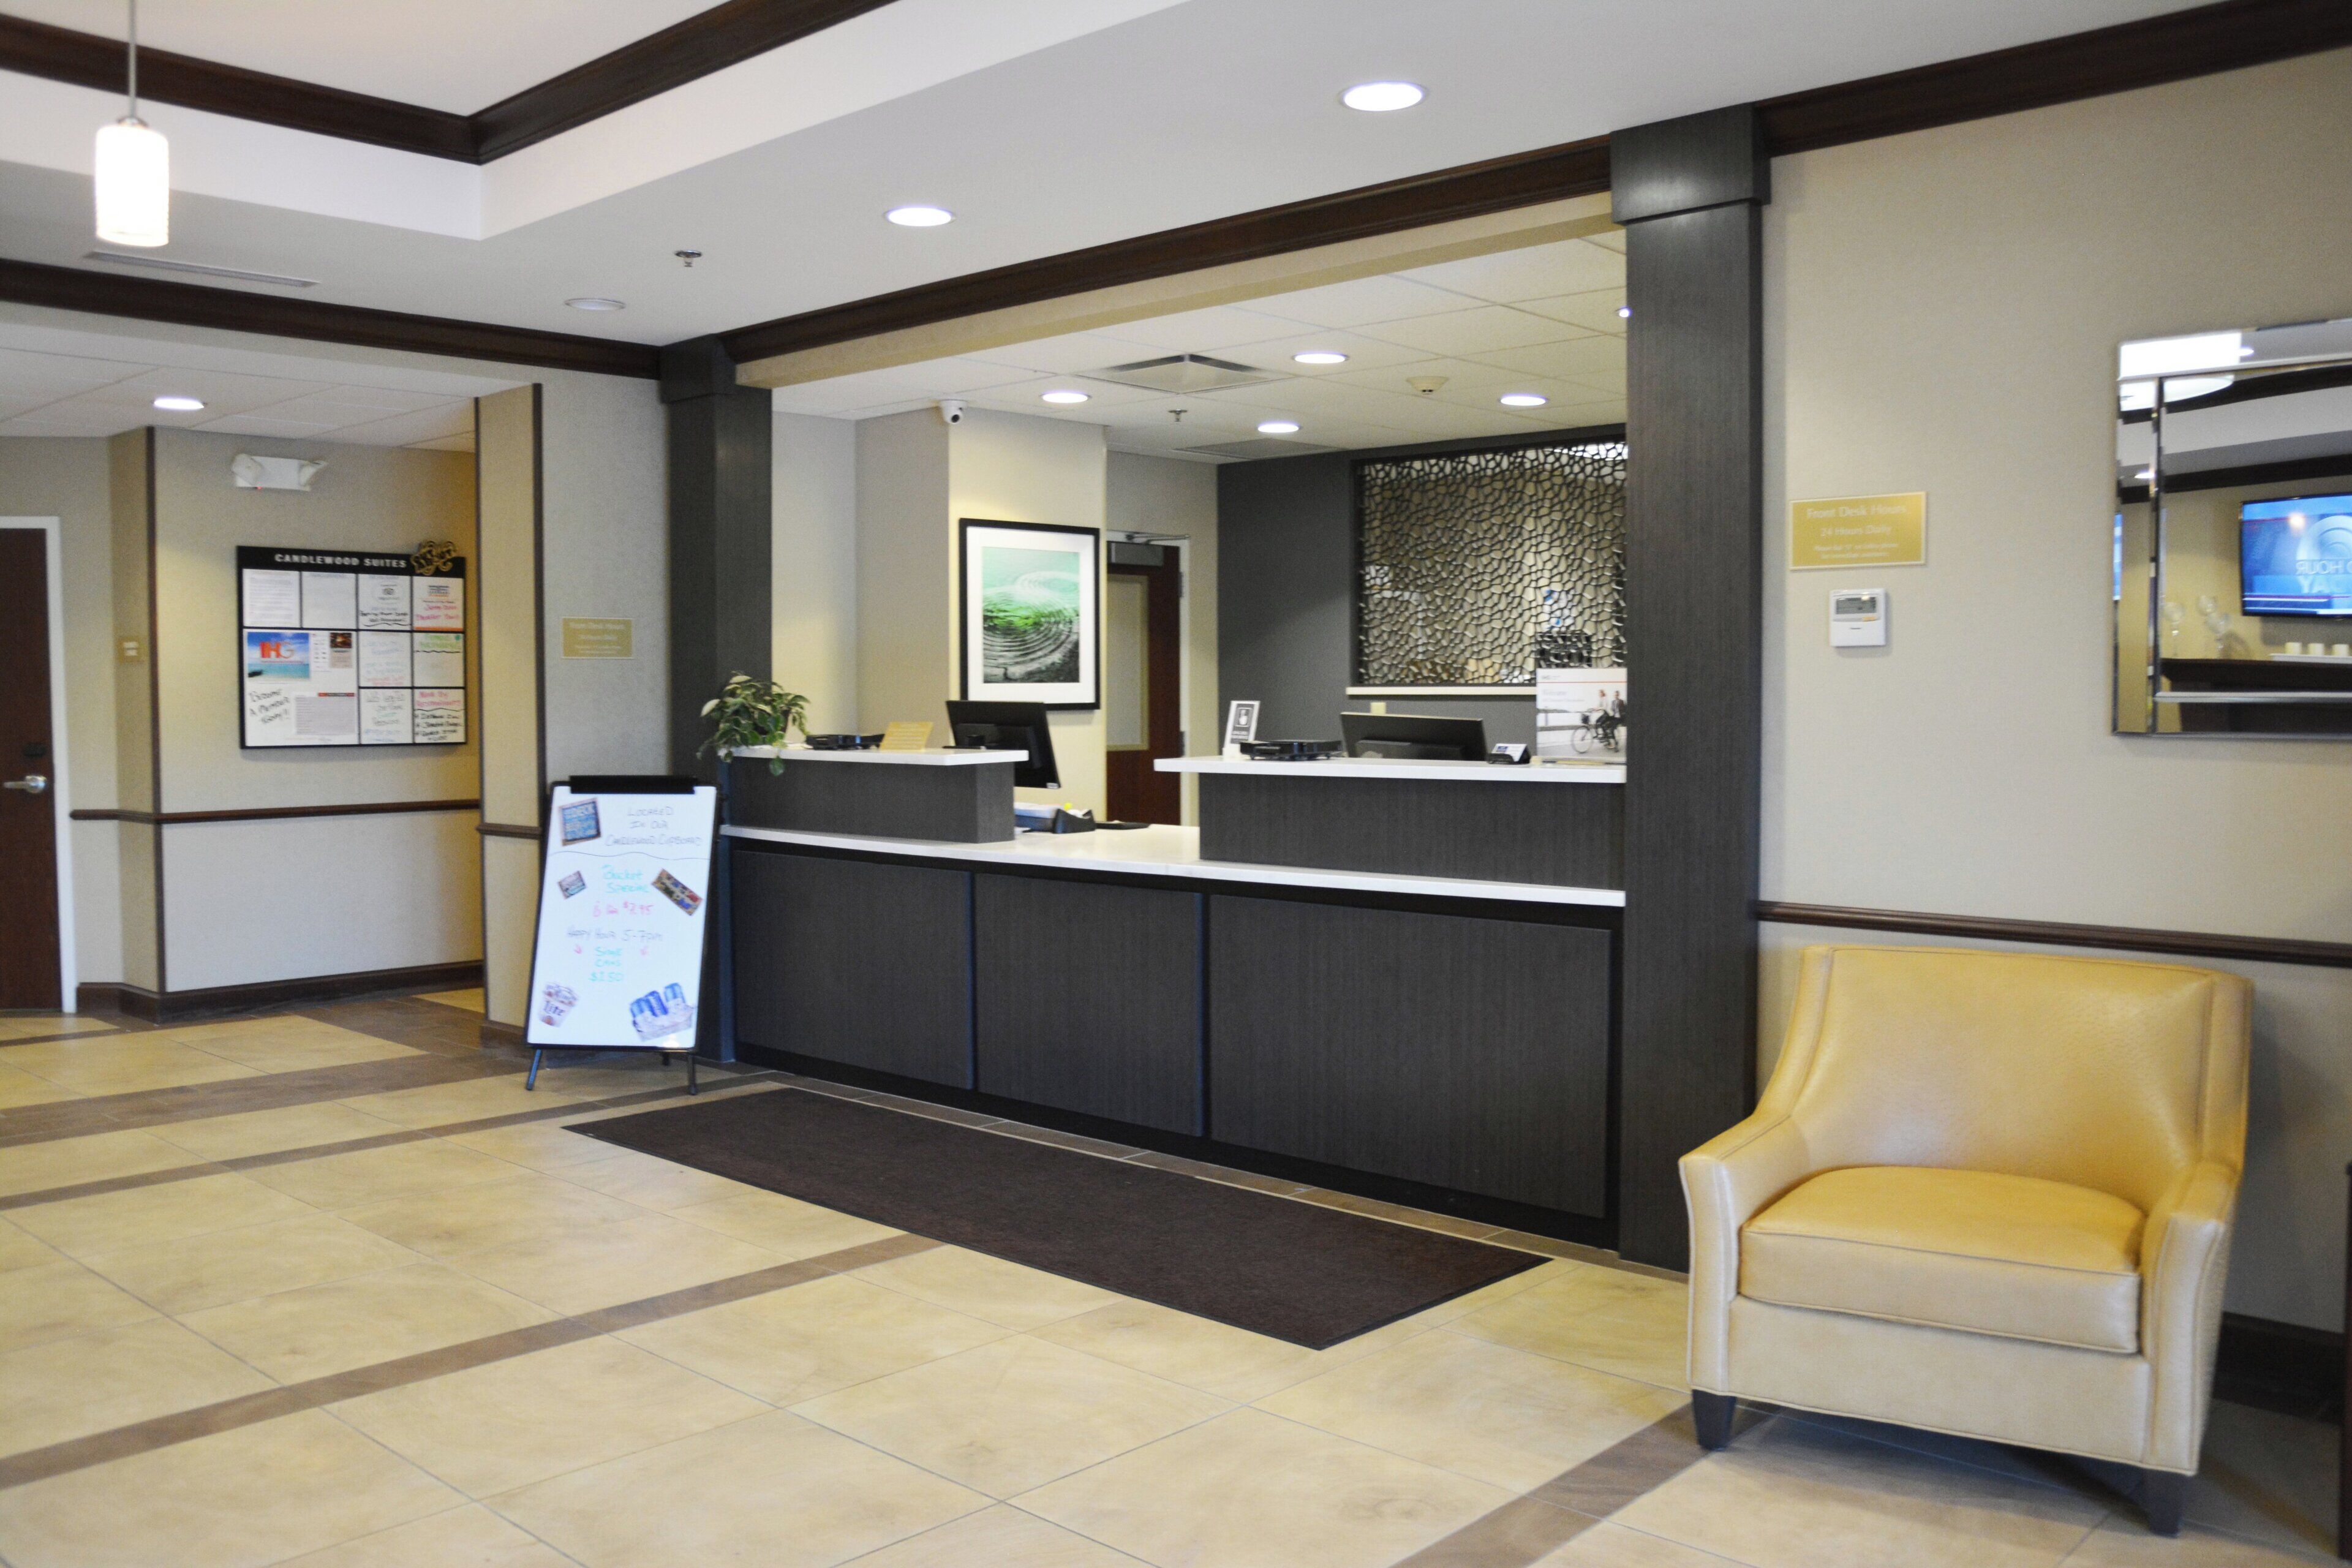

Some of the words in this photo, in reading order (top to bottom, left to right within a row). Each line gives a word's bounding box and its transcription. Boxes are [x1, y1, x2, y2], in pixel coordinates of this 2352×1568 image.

[1839, 505, 1867, 517] Desk
[1870, 503, 1907, 516] Hours
[275, 554, 360, 565] CANDLEWOOD
[363, 558, 407, 568] SUITES
[260, 641, 295, 658] IHG
[627, 805, 674, 816] LOCATED
[605, 834, 656, 846] CANDLEWOOD
